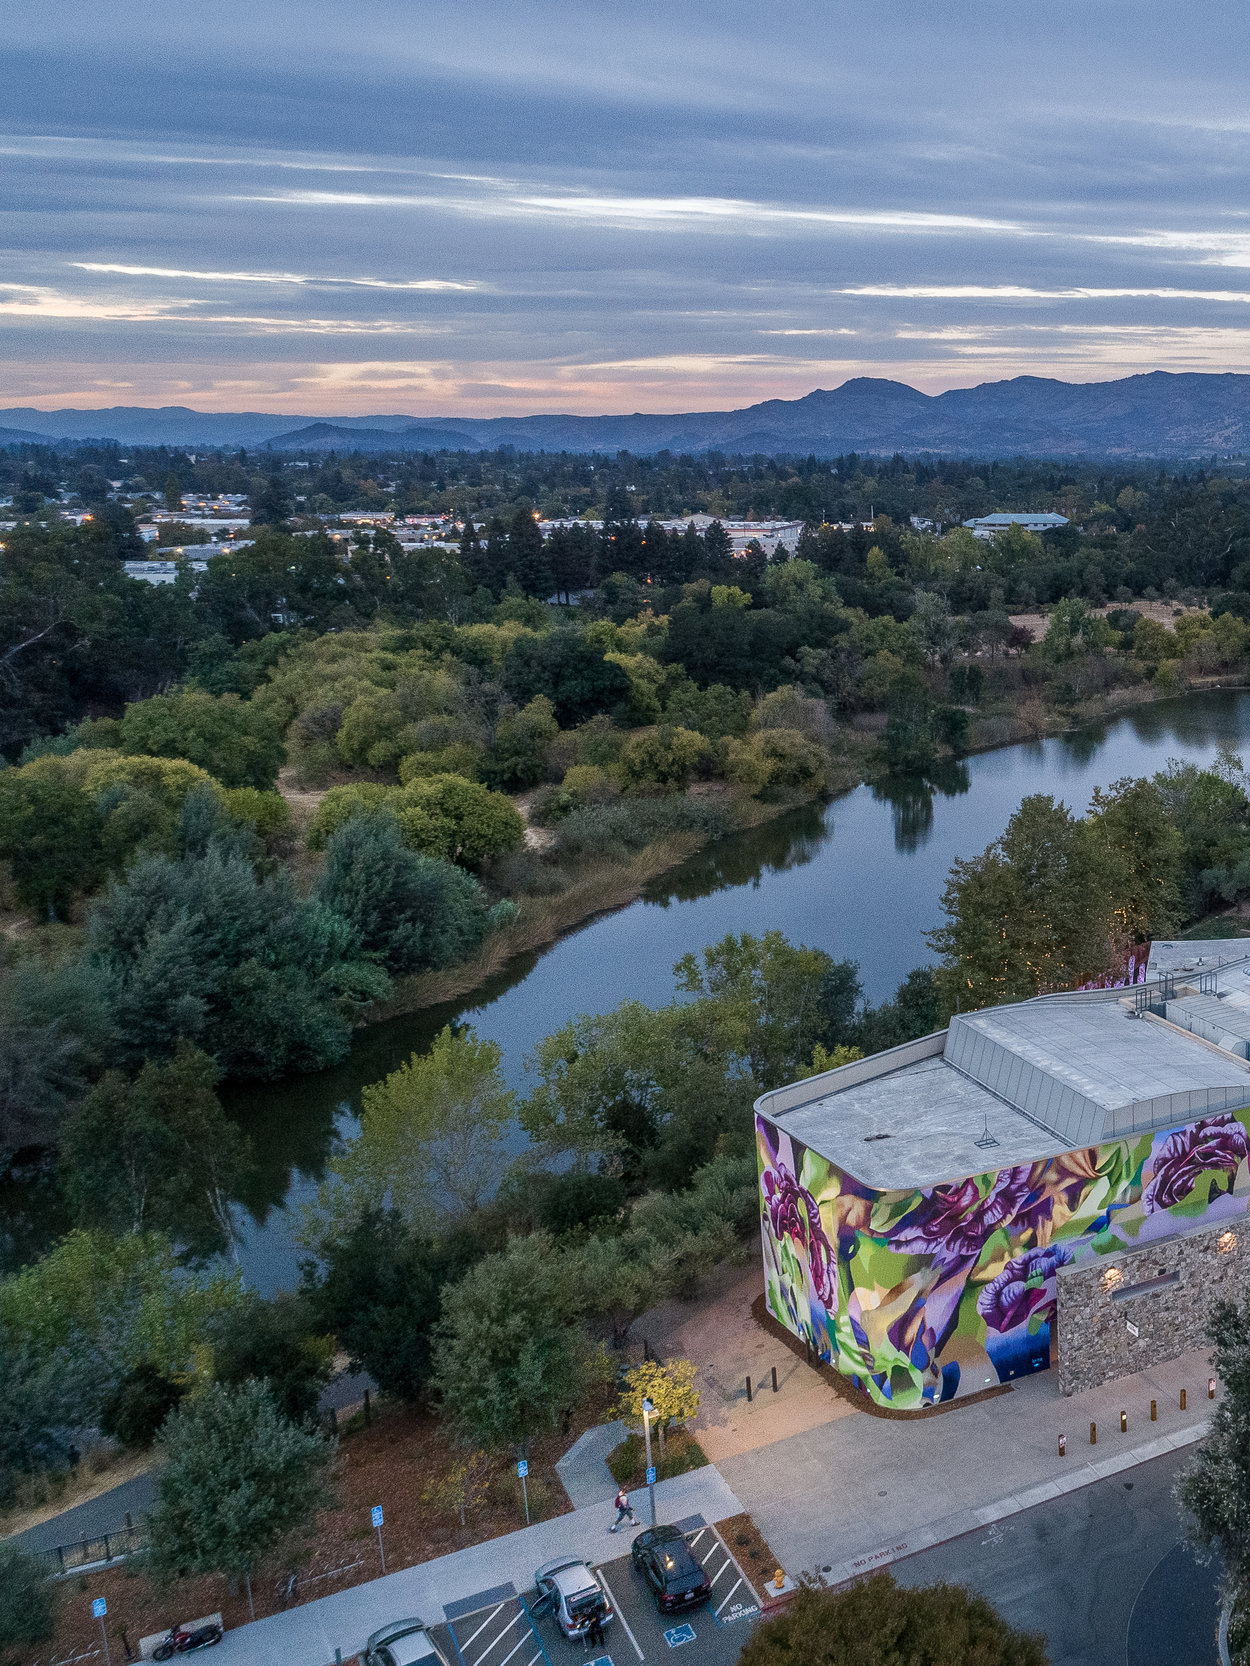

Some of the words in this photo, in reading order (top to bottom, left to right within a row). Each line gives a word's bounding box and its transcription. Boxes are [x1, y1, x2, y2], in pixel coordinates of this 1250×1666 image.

[853, 1559, 867, 1568] NO
[867, 1542, 908, 1562] PARKING
[721, 1604, 759, 1624] PARKING
[730, 1603, 743, 1613] NO
